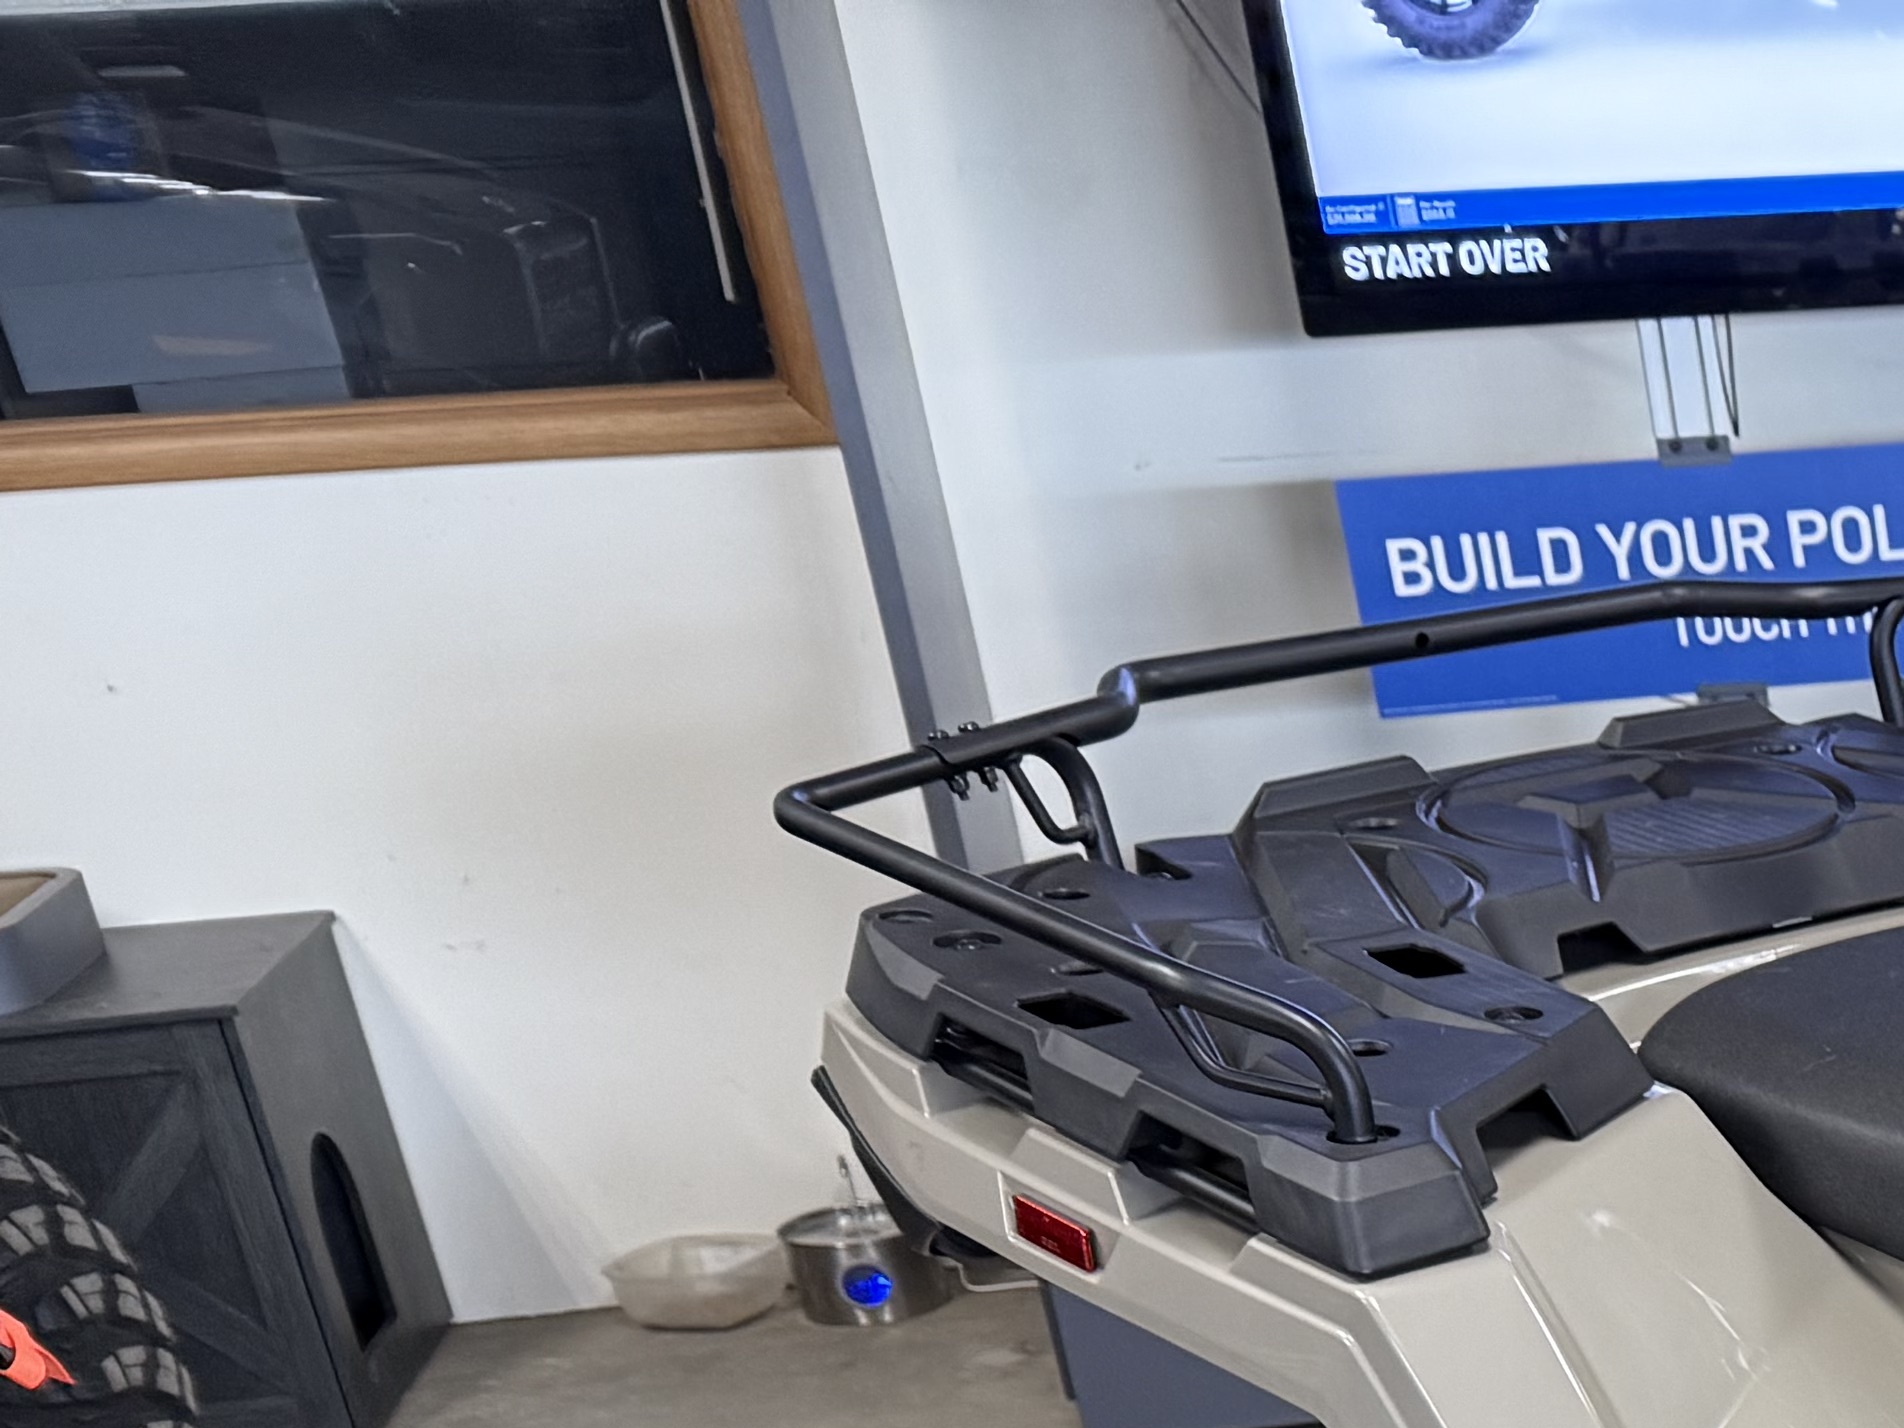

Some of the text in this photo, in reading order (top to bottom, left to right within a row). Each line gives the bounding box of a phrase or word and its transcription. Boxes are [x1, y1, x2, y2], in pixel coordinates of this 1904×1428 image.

[1342, 237, 1552, 282] START OVER
[1387, 526, 1583, 598] BUILD
[1594, 512, 1769, 580] YOUR
